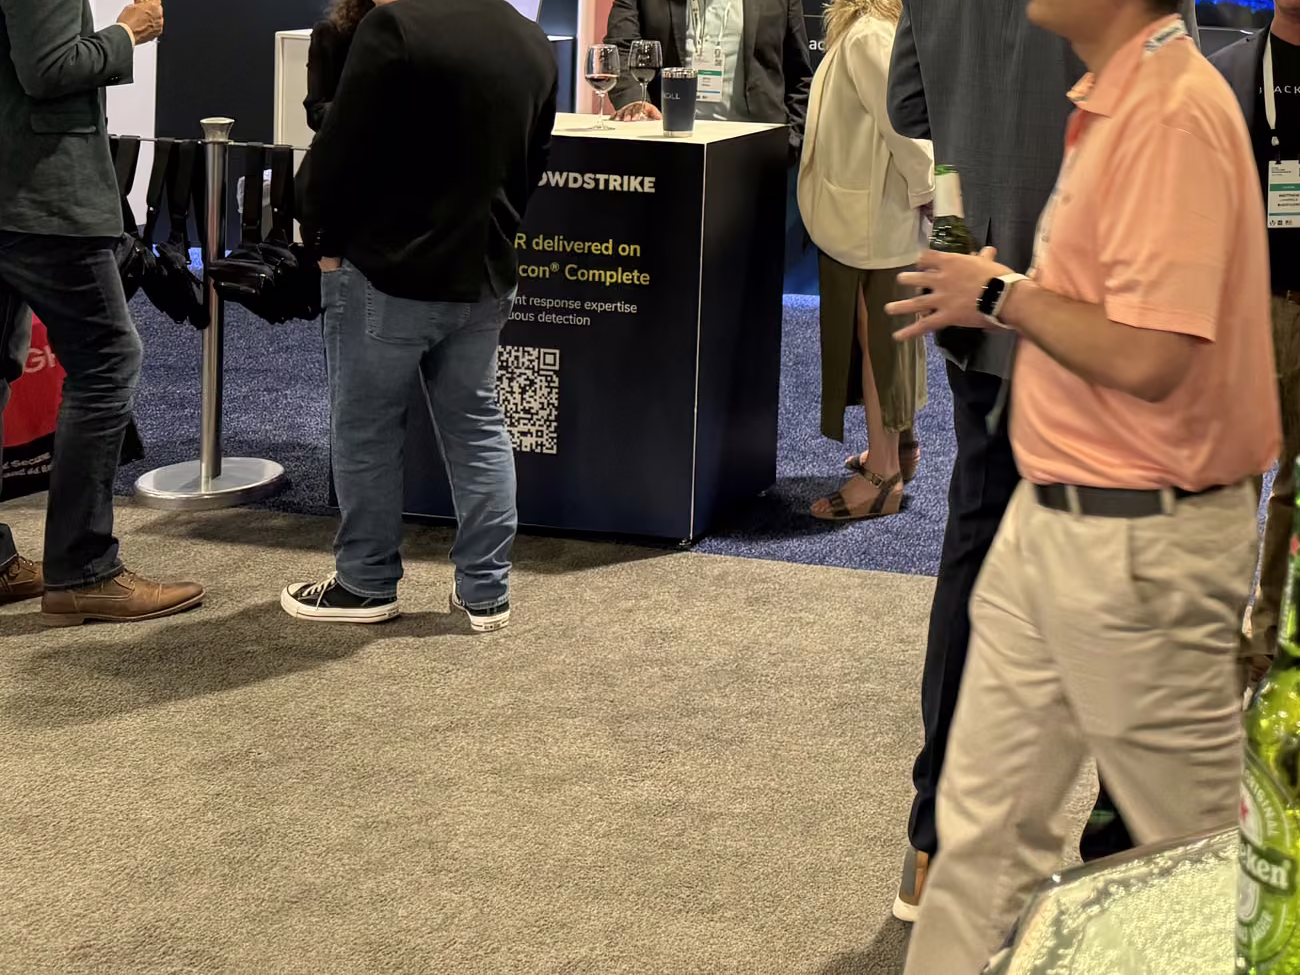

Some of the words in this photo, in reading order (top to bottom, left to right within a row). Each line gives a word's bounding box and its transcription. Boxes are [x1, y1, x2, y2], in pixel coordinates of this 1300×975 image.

[532, 234, 613, 255] delivered
[618, 243, 641, 256] on
[564, 264, 650, 286] Complete
[530, 296, 581, 310] response
[584, 300, 638, 313] expertise
[538, 311, 591, 326] detection
